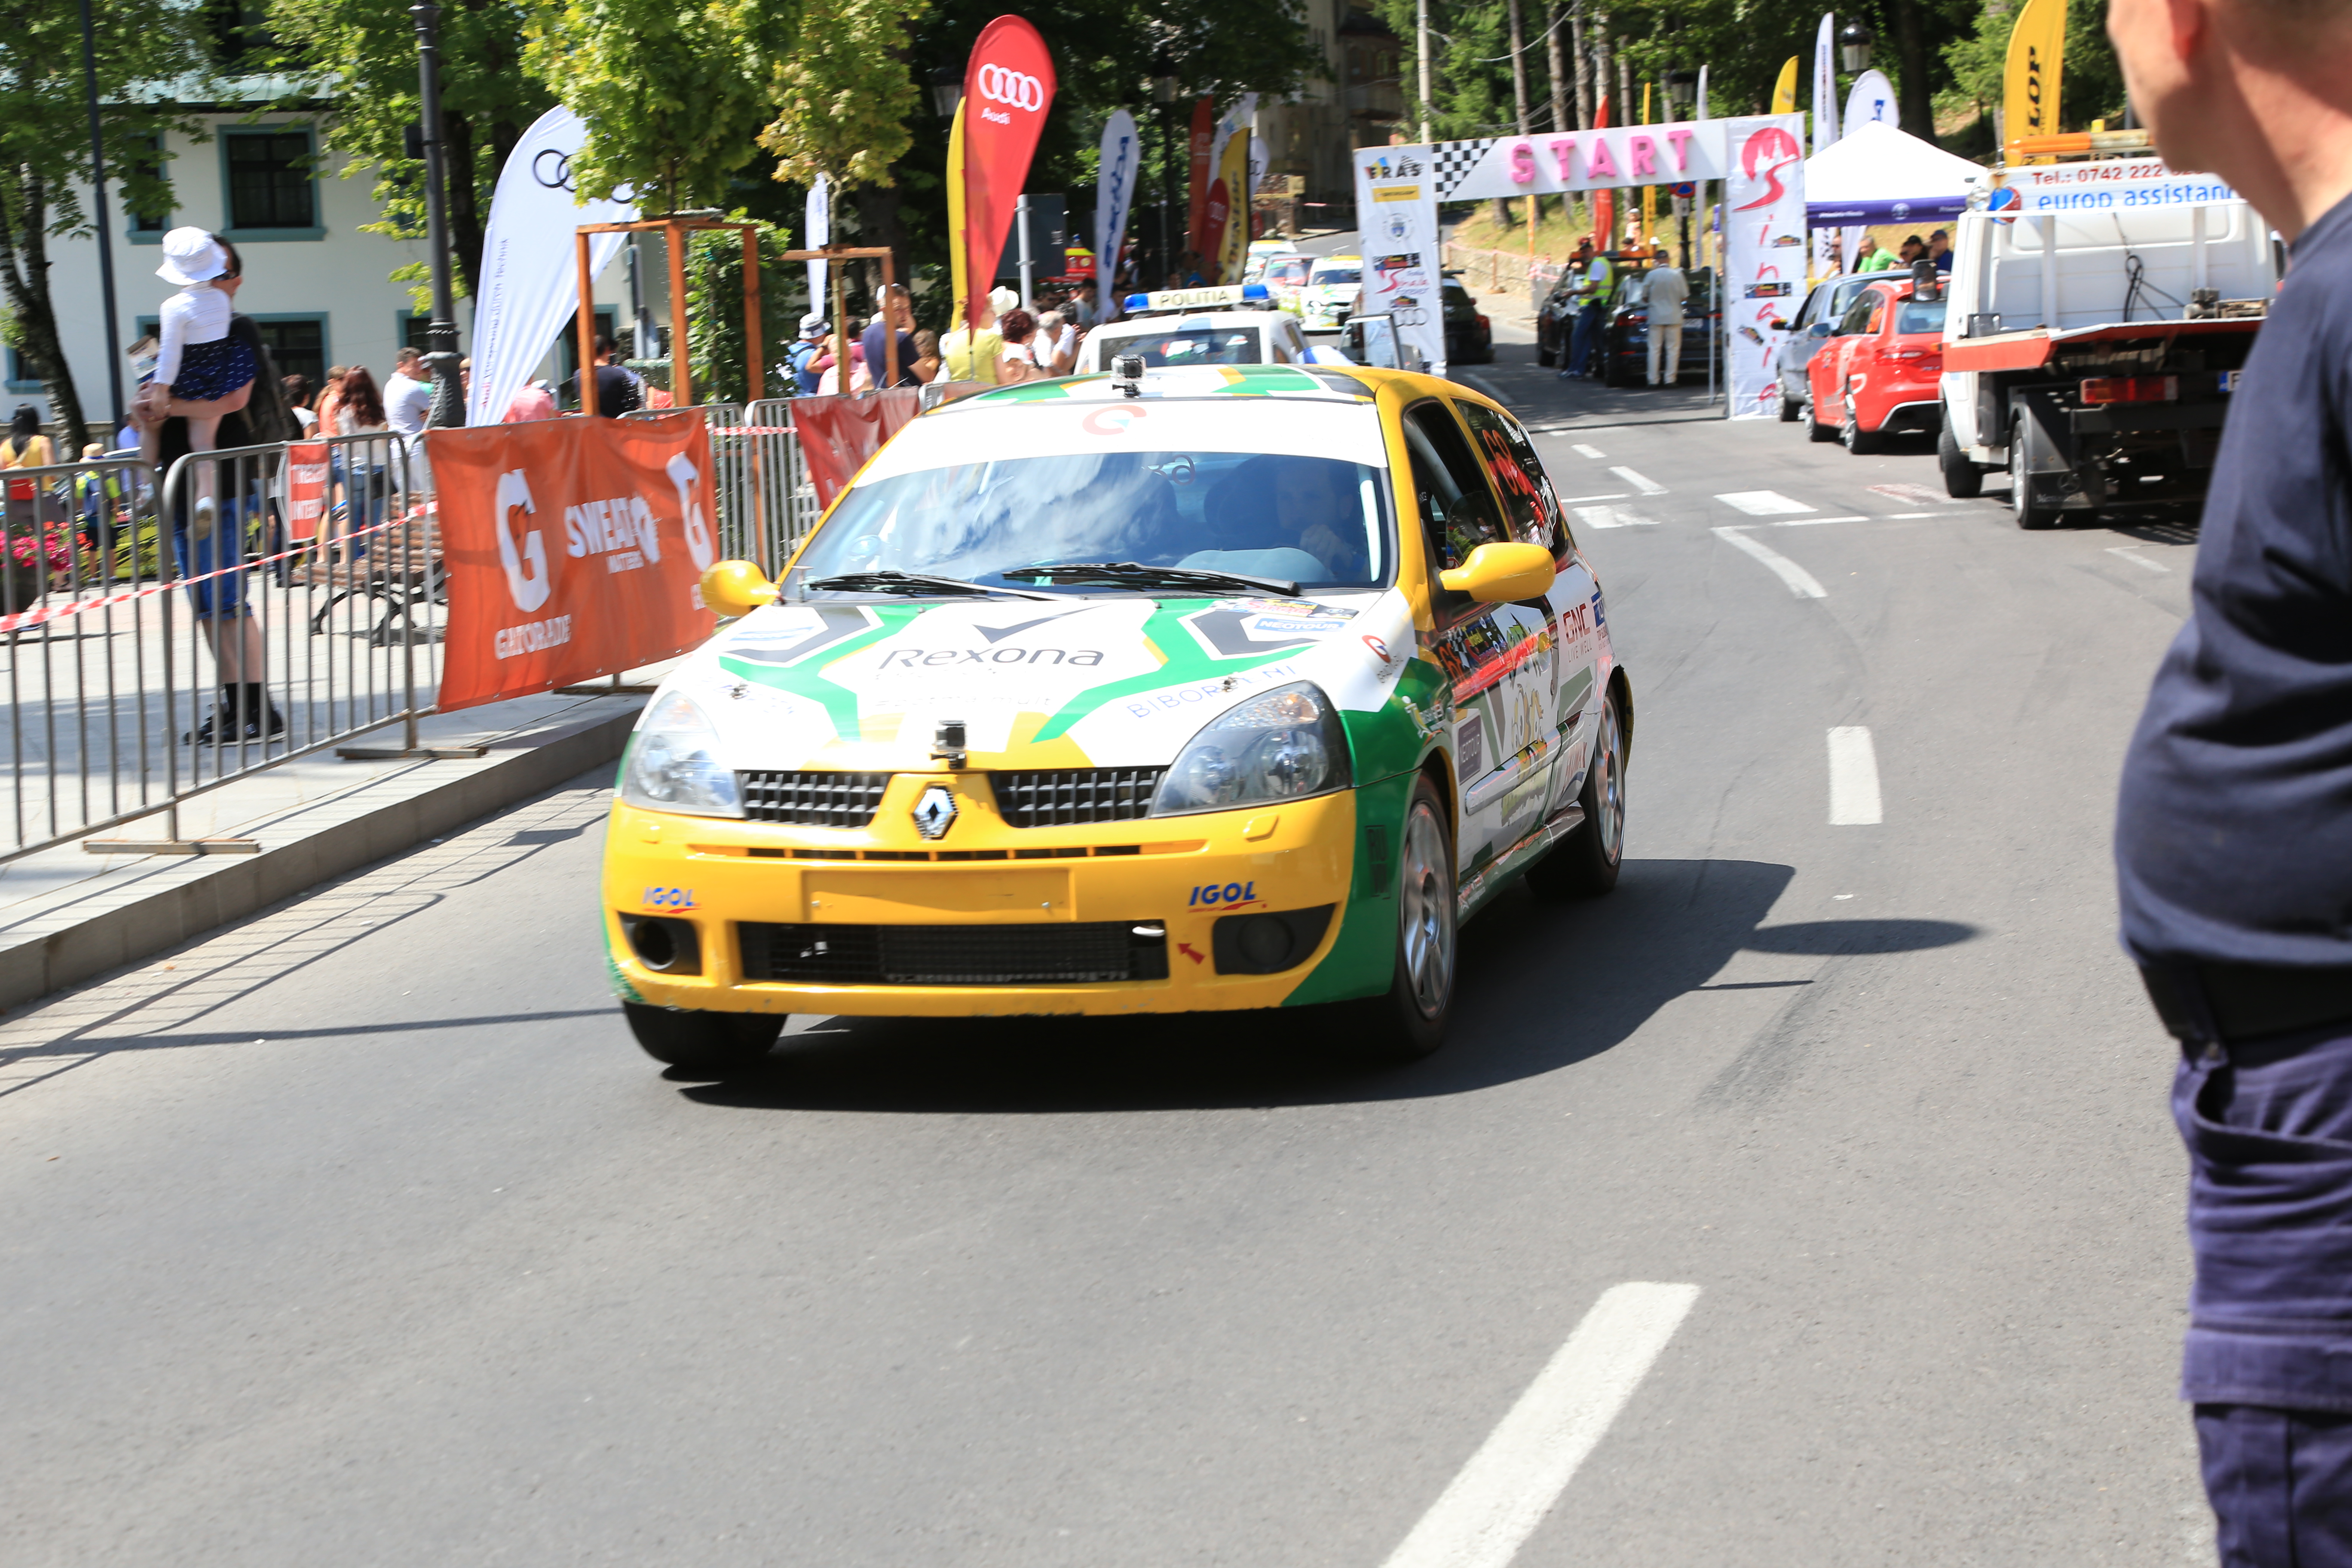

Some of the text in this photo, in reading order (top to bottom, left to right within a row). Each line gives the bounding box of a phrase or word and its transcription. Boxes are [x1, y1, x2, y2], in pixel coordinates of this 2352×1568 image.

[981, 107, 1011, 125] Audi
[1510, 129, 1693, 183] START
[2077, 167, 2122, 183] 0742
[2129, 164, 2162, 179] 222
[2124, 184, 2233, 206] assistan
[1259, 620, 1340, 630] NEOTOUR
[1562, 603, 1590, 644] GNC
[494, 613, 572, 660] GATORADE
[878, 648, 1104, 670] Rexona
[1568, 638, 1592, 663] LIVE WELL
[1126, 665, 1297, 718] BIBORENI
[642, 886, 695, 907] IGOL
[1188, 881, 1257, 906] IGOL
